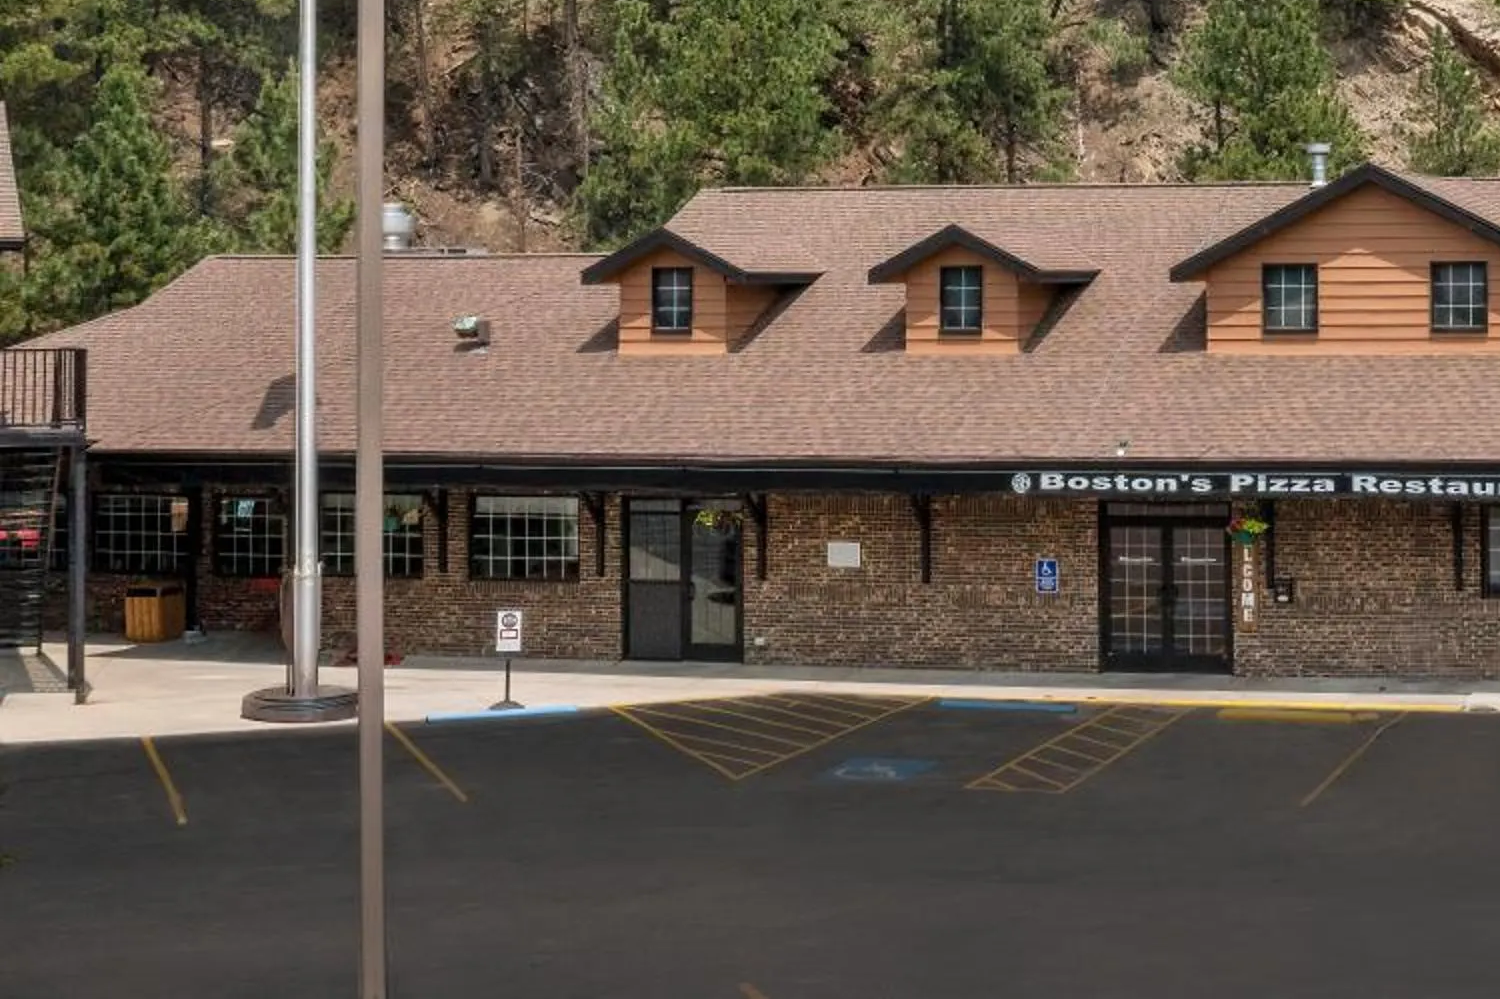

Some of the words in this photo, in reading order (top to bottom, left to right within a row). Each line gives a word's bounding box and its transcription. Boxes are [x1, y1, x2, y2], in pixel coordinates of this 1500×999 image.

[1039, 473, 1213, 493] Boston's
[1230, 474, 1335, 493] Pizza
[1242, 544, 1254, 622] LCOME
